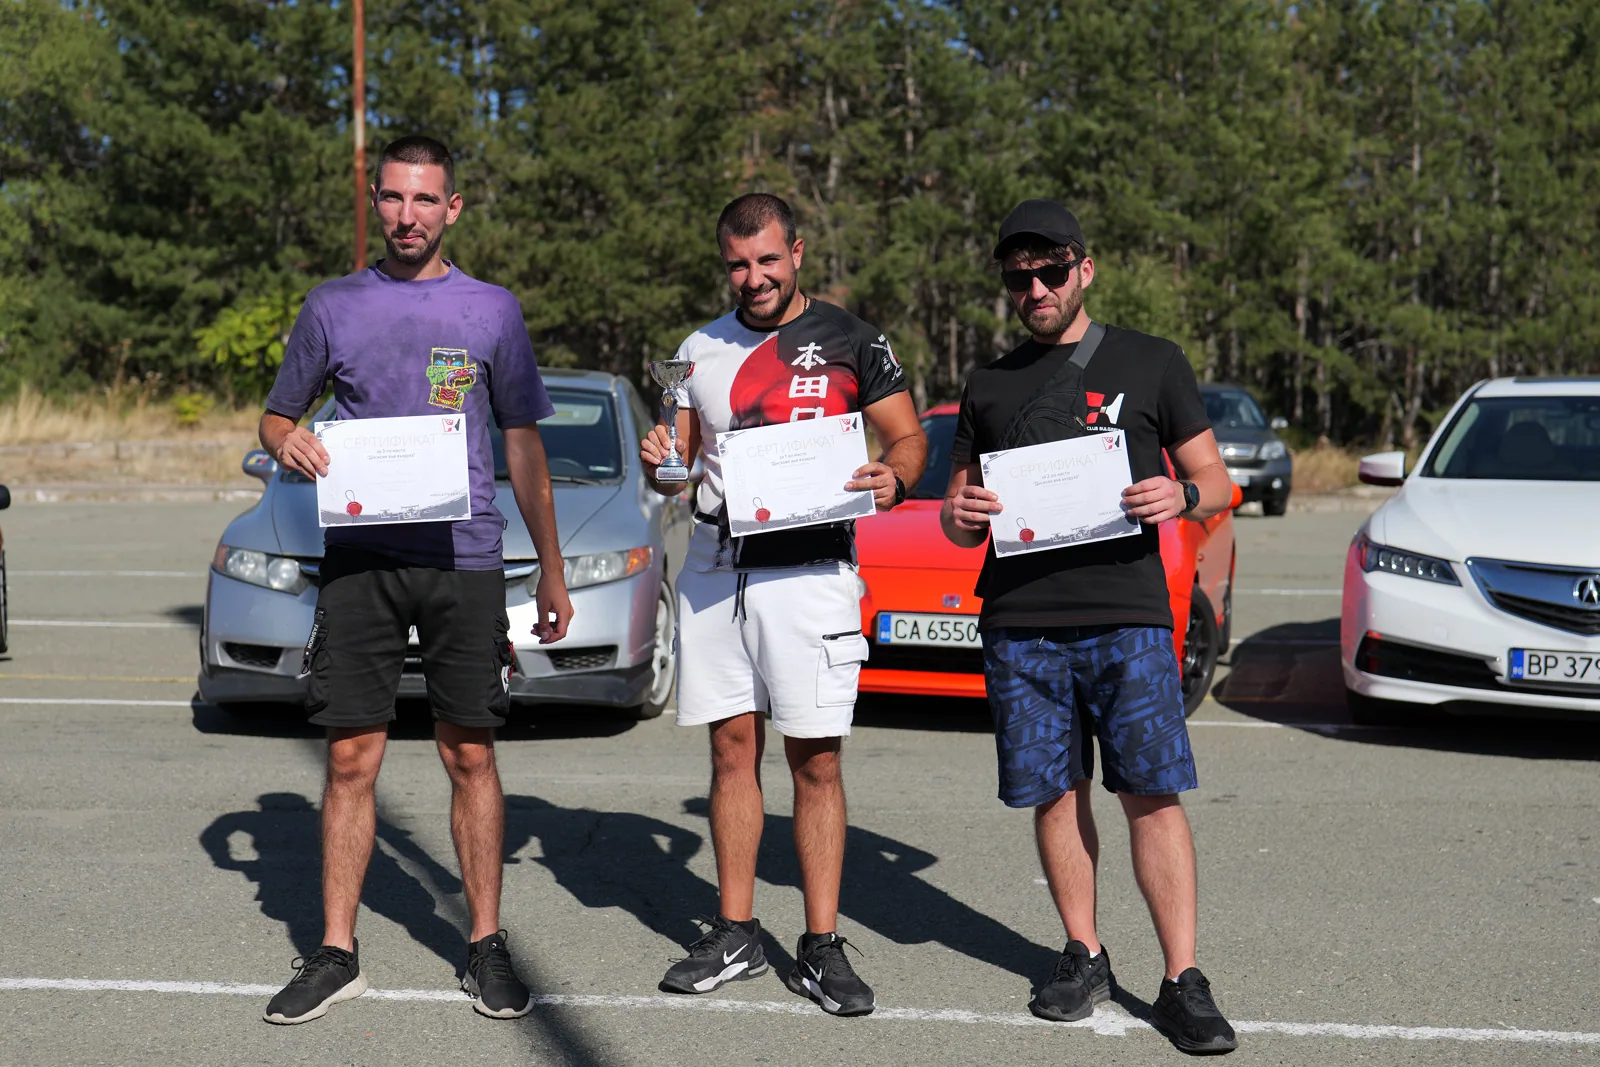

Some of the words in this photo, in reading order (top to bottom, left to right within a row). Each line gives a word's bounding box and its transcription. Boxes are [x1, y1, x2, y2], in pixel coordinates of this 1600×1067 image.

[343, 433, 438, 450] СЕРТИФИКАТ
[746, 434, 837, 458] СЕРТИФИКАТ
[1009, 453, 1099, 479] СЕРТИФИКАТ
[308, 624, 318, 649] FASHION
[894, 619, 921, 640] CA
[926, 620, 979, 643] 6550
[1527, 654, 1559, 676] BP
